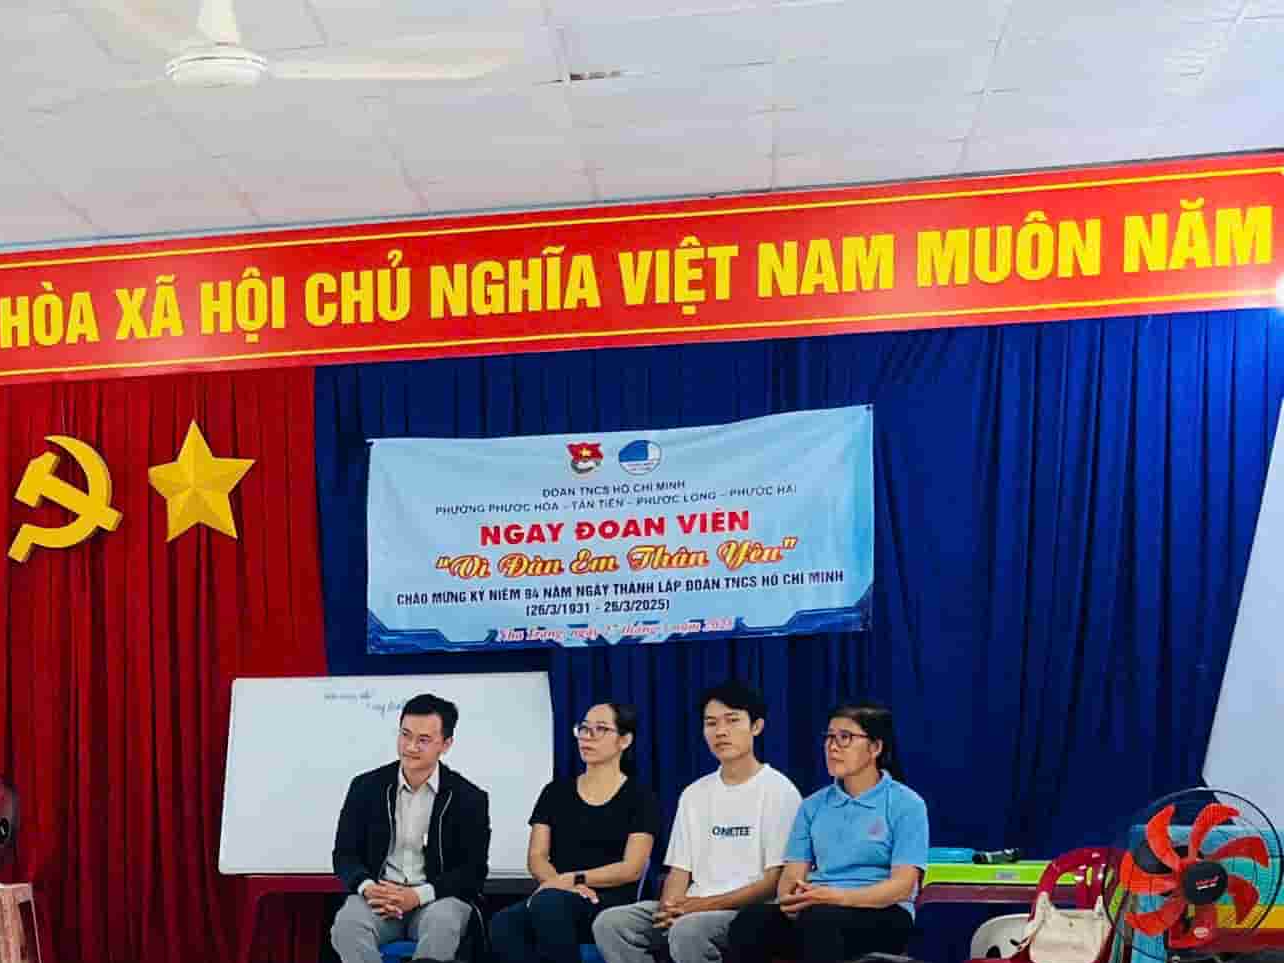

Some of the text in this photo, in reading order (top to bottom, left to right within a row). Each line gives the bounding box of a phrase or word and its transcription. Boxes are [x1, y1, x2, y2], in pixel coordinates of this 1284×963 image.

[0, 282, 99, 346] HÒA
[115, 276, 183, 340] XÃ
[201, 267, 284, 344] HỘI
[305, 249, 407, 326] CHỦ
[430, 243, 600, 320] NGHĨA
[618, 236, 739, 315] VIỆT
[757, 234, 895, 298] NAM
[916, 211, 1102, 288] MUÔN
[1123, 198, 1272, 273] NĂM
[580, 485, 610, 497] TNCS
[656, 480, 685, 491] MINH
[570, 548, 619, 574] Em
[627, 544, 709, 570] Thân
[724, 575, 757, 589] TNCS
[808, 569, 844, 584] MINH
